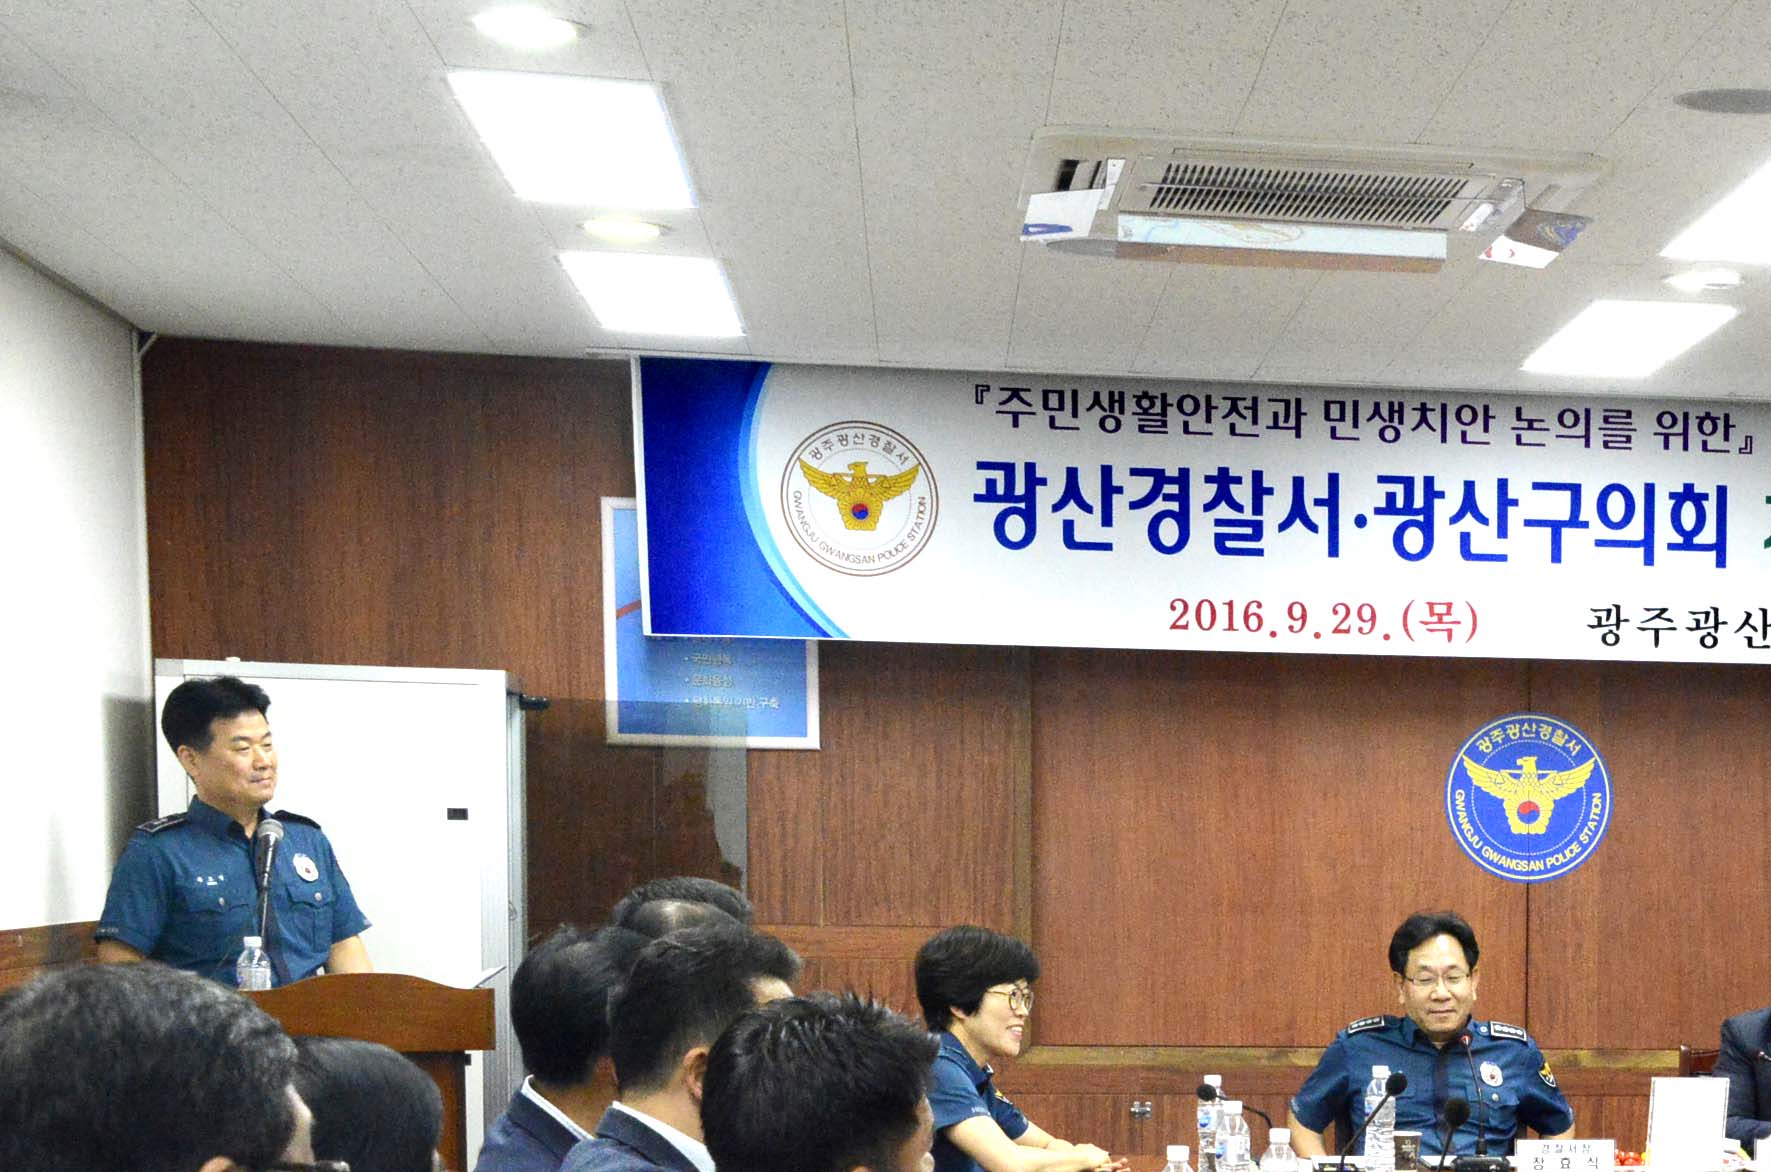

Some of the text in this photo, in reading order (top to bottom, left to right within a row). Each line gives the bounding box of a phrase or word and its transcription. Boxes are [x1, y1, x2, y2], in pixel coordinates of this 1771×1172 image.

[808, 432, 910, 465] 광주광산경찰서
[974, 384, 1754, 455] 『주민생활안전과 민생치안 논의를 위한』
[793, 490, 927, 564] GWANGJU GWANGSAN POLICE STATION
[1475, 722, 1582, 757] 광주광산경찰서
[1455, 788, 1602, 871] GWANGJU GWANGSAN POLICE STATION
